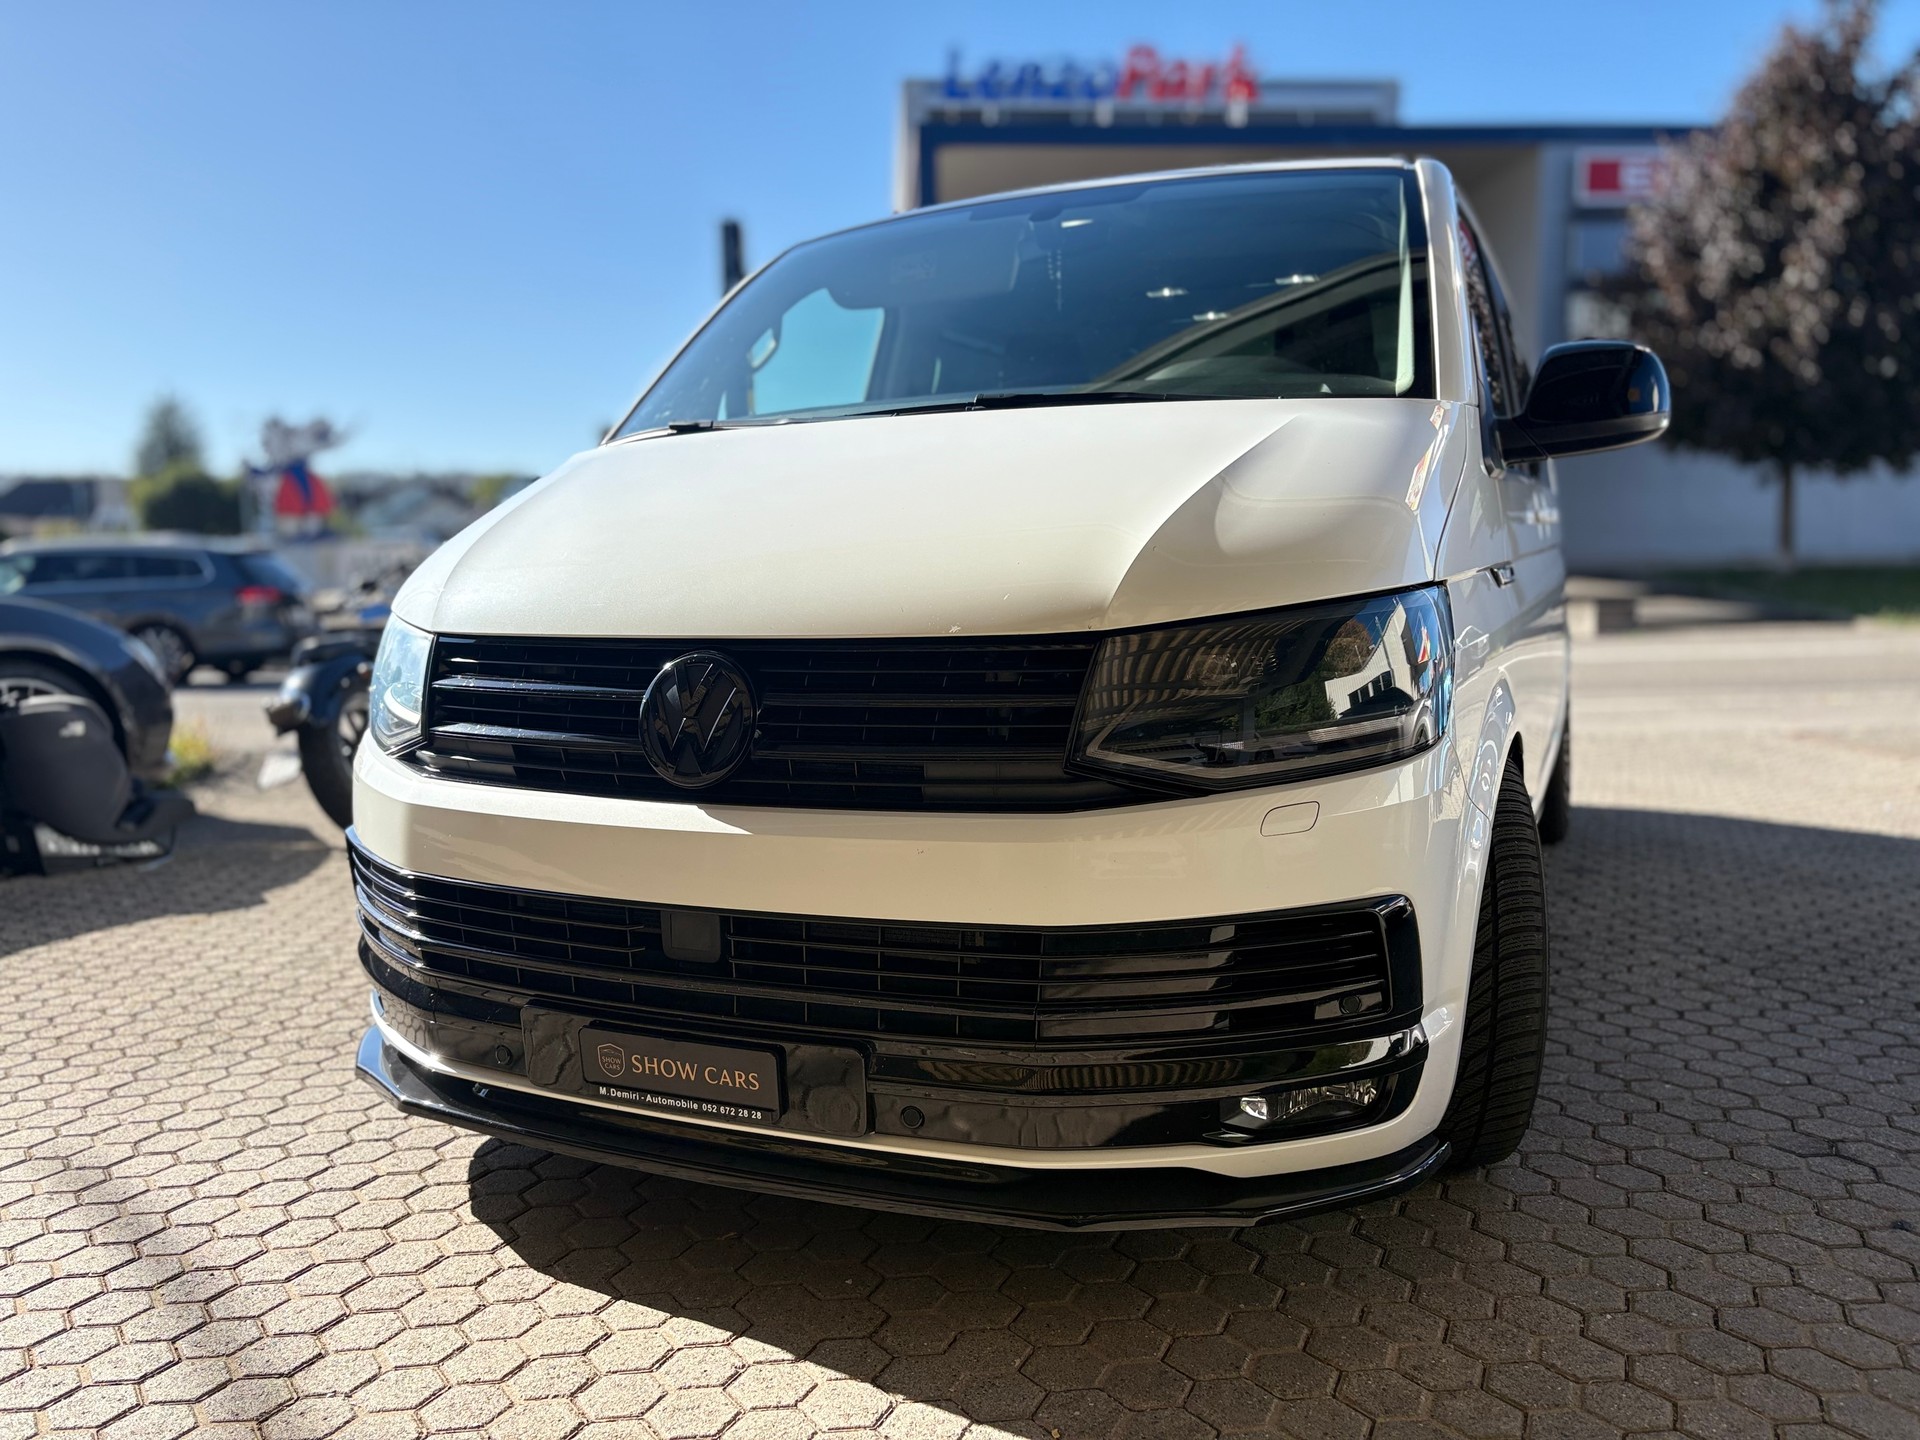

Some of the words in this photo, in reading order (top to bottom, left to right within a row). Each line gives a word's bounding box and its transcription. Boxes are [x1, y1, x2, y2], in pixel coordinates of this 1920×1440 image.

[602, 1056, 622, 1065] SHOW
[604, 1062, 621, 1071] CARS
[631, 1054, 698, 1081] SHOW
[704, 1067, 760, 1091] CARS
[645, 1094, 699, 1110] Automobile
[702, 1103, 718, 1113] 052
[720, 1106, 736, 1116] 672
[738, 1109, 749, 1118] 28
[751, 1111, 762, 1120] 28
